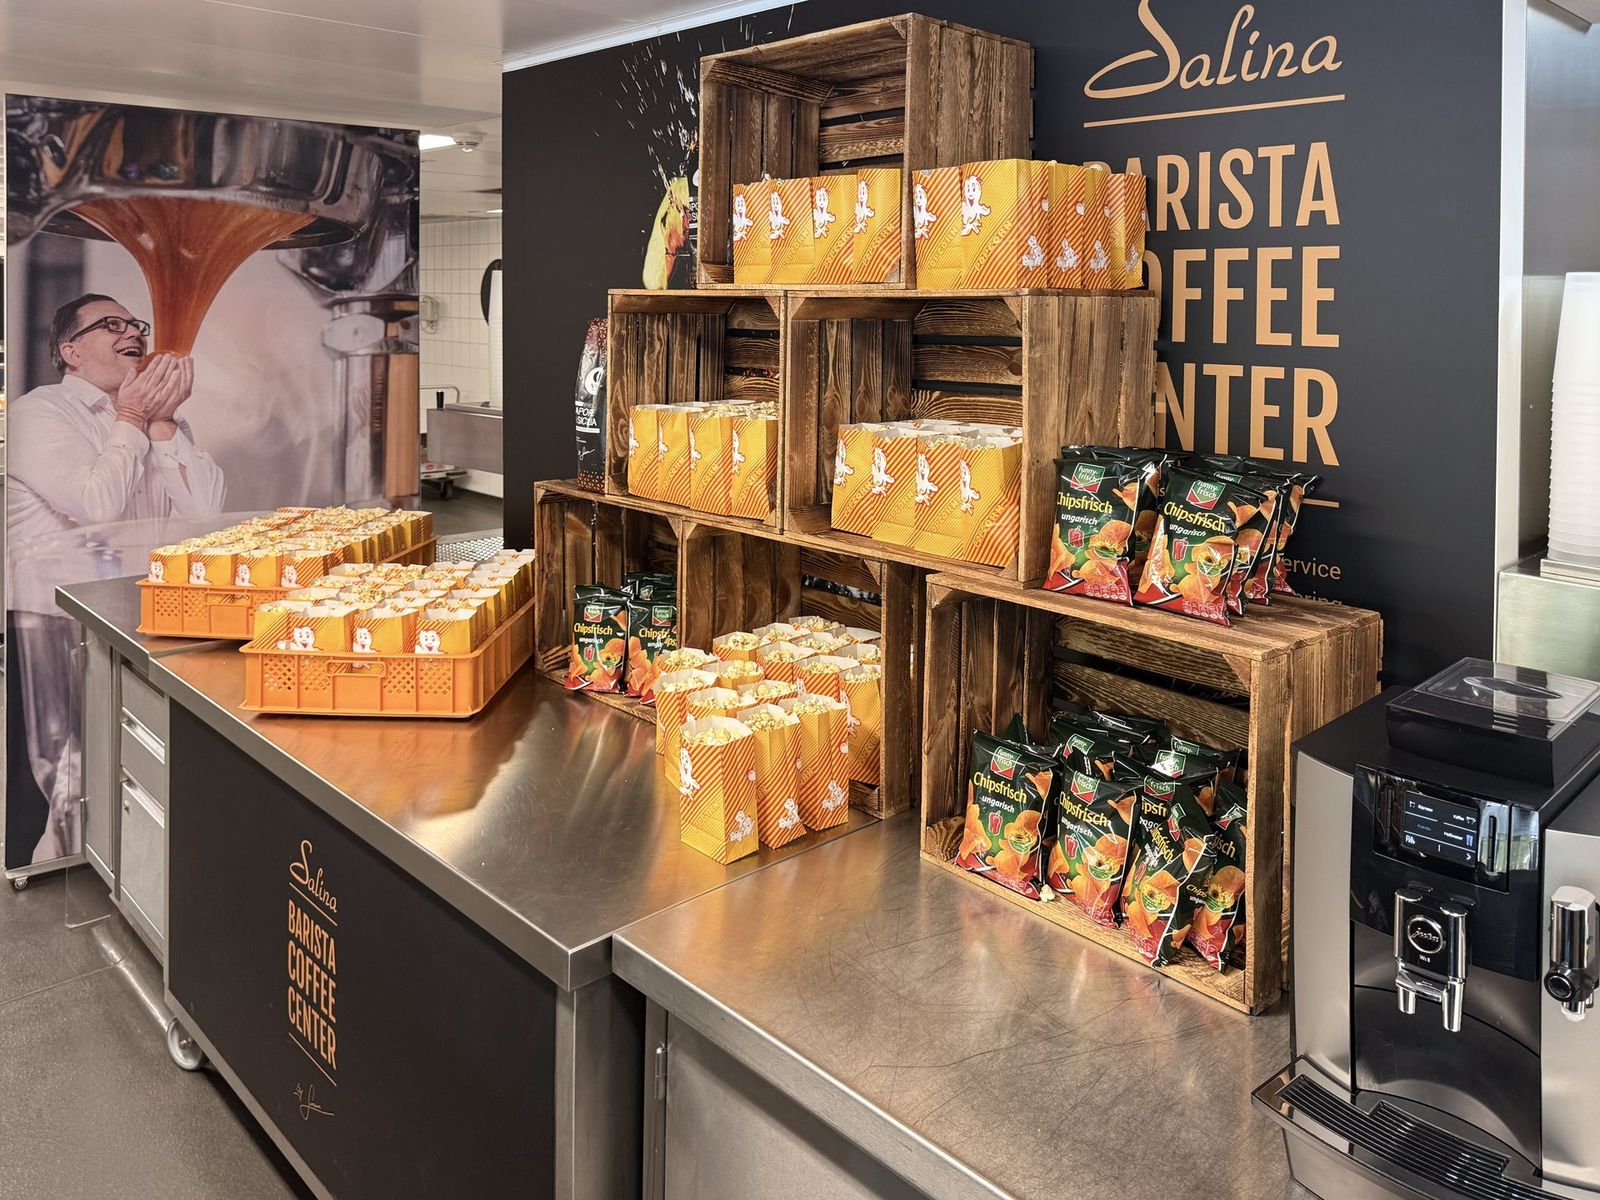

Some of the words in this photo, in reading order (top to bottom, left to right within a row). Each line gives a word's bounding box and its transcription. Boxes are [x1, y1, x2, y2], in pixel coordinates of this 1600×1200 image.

[1083, 0, 1344, 99] Salina
[1083, 142, 1341, 233] RISTA
[974, 220, 1014, 272] POPCORN
[1143, 245, 1341, 348] FFEE
[1155, 362, 1340, 467] NTER
[1061, 513, 1098, 526] ungarisch
[1164, 501, 1226, 533] Chipsfrisch
[1169, 523, 1207, 537] ungarisch
[1282, 557, 1341, 580] ervice
[573, 622, 613, 635] Chipsfrisch
[973, 771, 1027, 804] Chipsfrisch
[981, 795, 1015, 814] ungarisch
[1060, 791, 1108, 827] Chipsfrisch
[289, 839, 338, 913] Salina
[288, 899, 337, 976] BARISTA
[287, 939, 337, 1024] COFFEE
[287, 985, 337, 1071] CENTER
